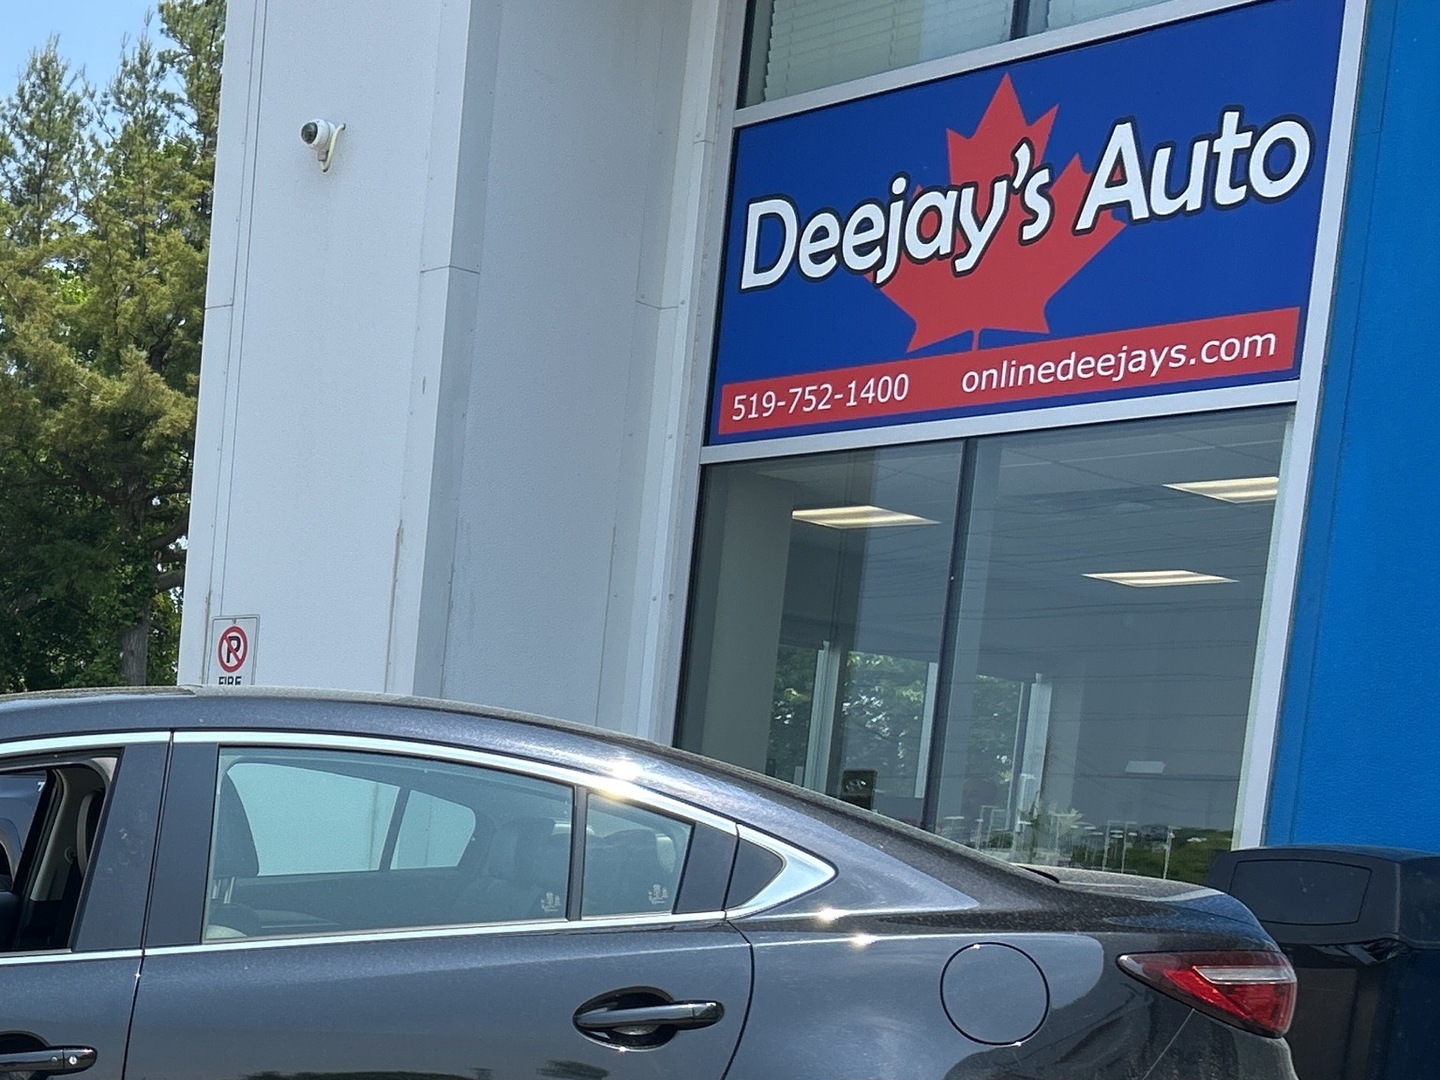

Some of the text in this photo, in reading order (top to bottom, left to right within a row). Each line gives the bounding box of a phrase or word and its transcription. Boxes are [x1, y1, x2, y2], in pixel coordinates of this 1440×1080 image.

[738, 109, 1313, 292] Deejay's Auto
[731, 329, 1278, 422] 519-752-1400 onlinedeejays.com
